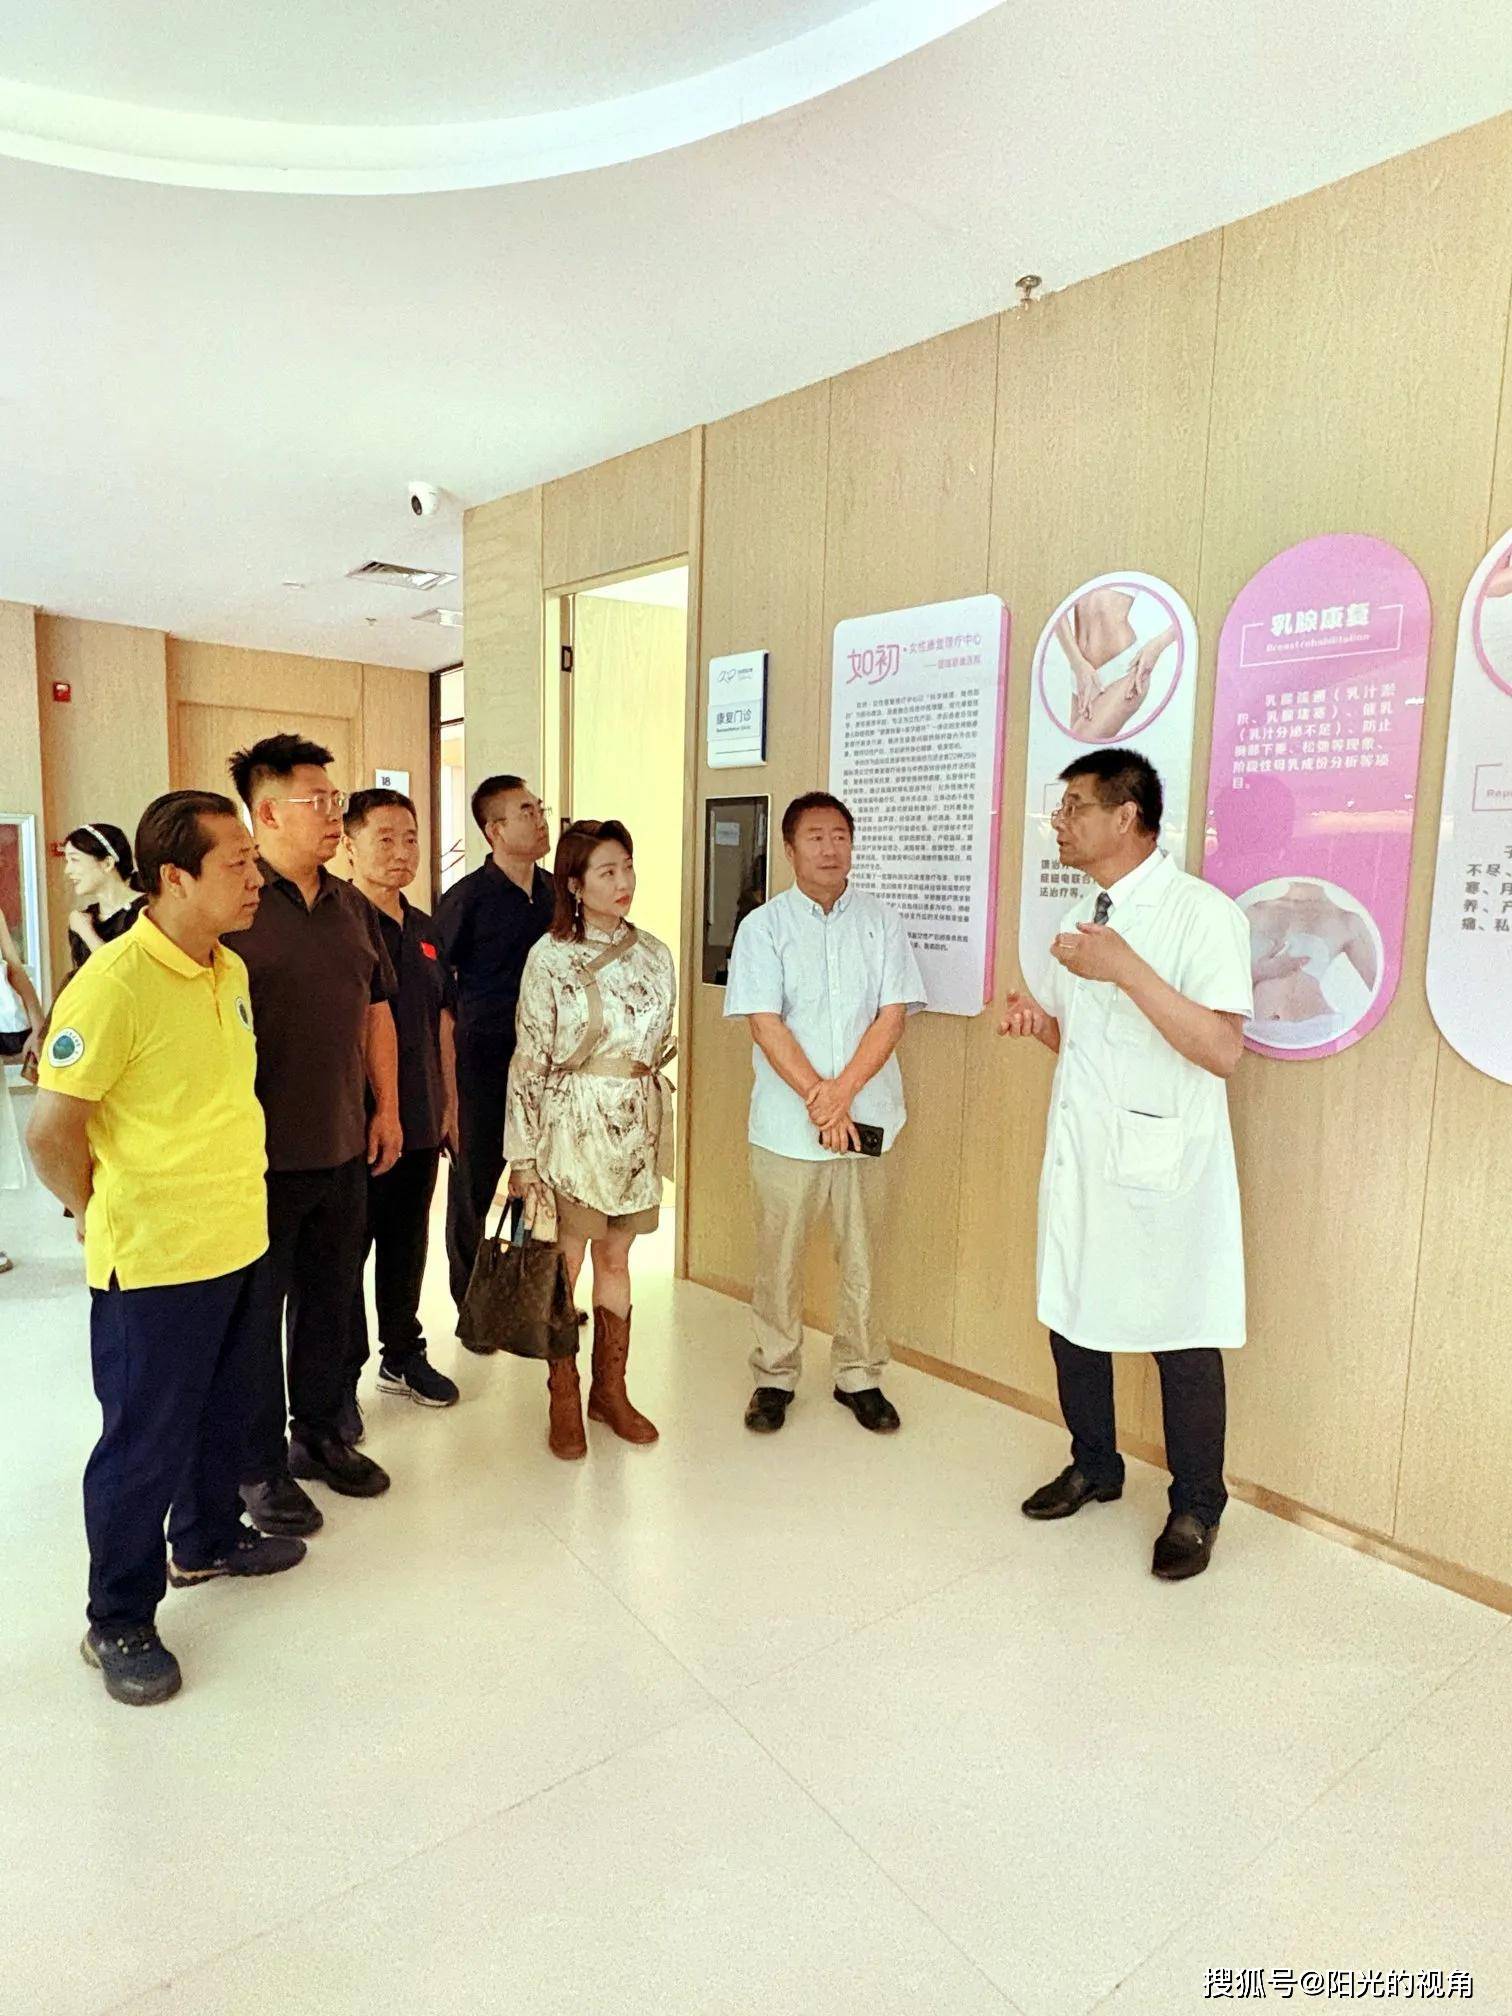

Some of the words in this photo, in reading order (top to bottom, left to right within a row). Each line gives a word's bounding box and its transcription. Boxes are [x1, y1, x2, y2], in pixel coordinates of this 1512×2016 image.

[1270, 601, 1370, 638] 乳腺康复
[846, 643, 900, 685] 如初
[1486, 788, 1512, 800] Rep
